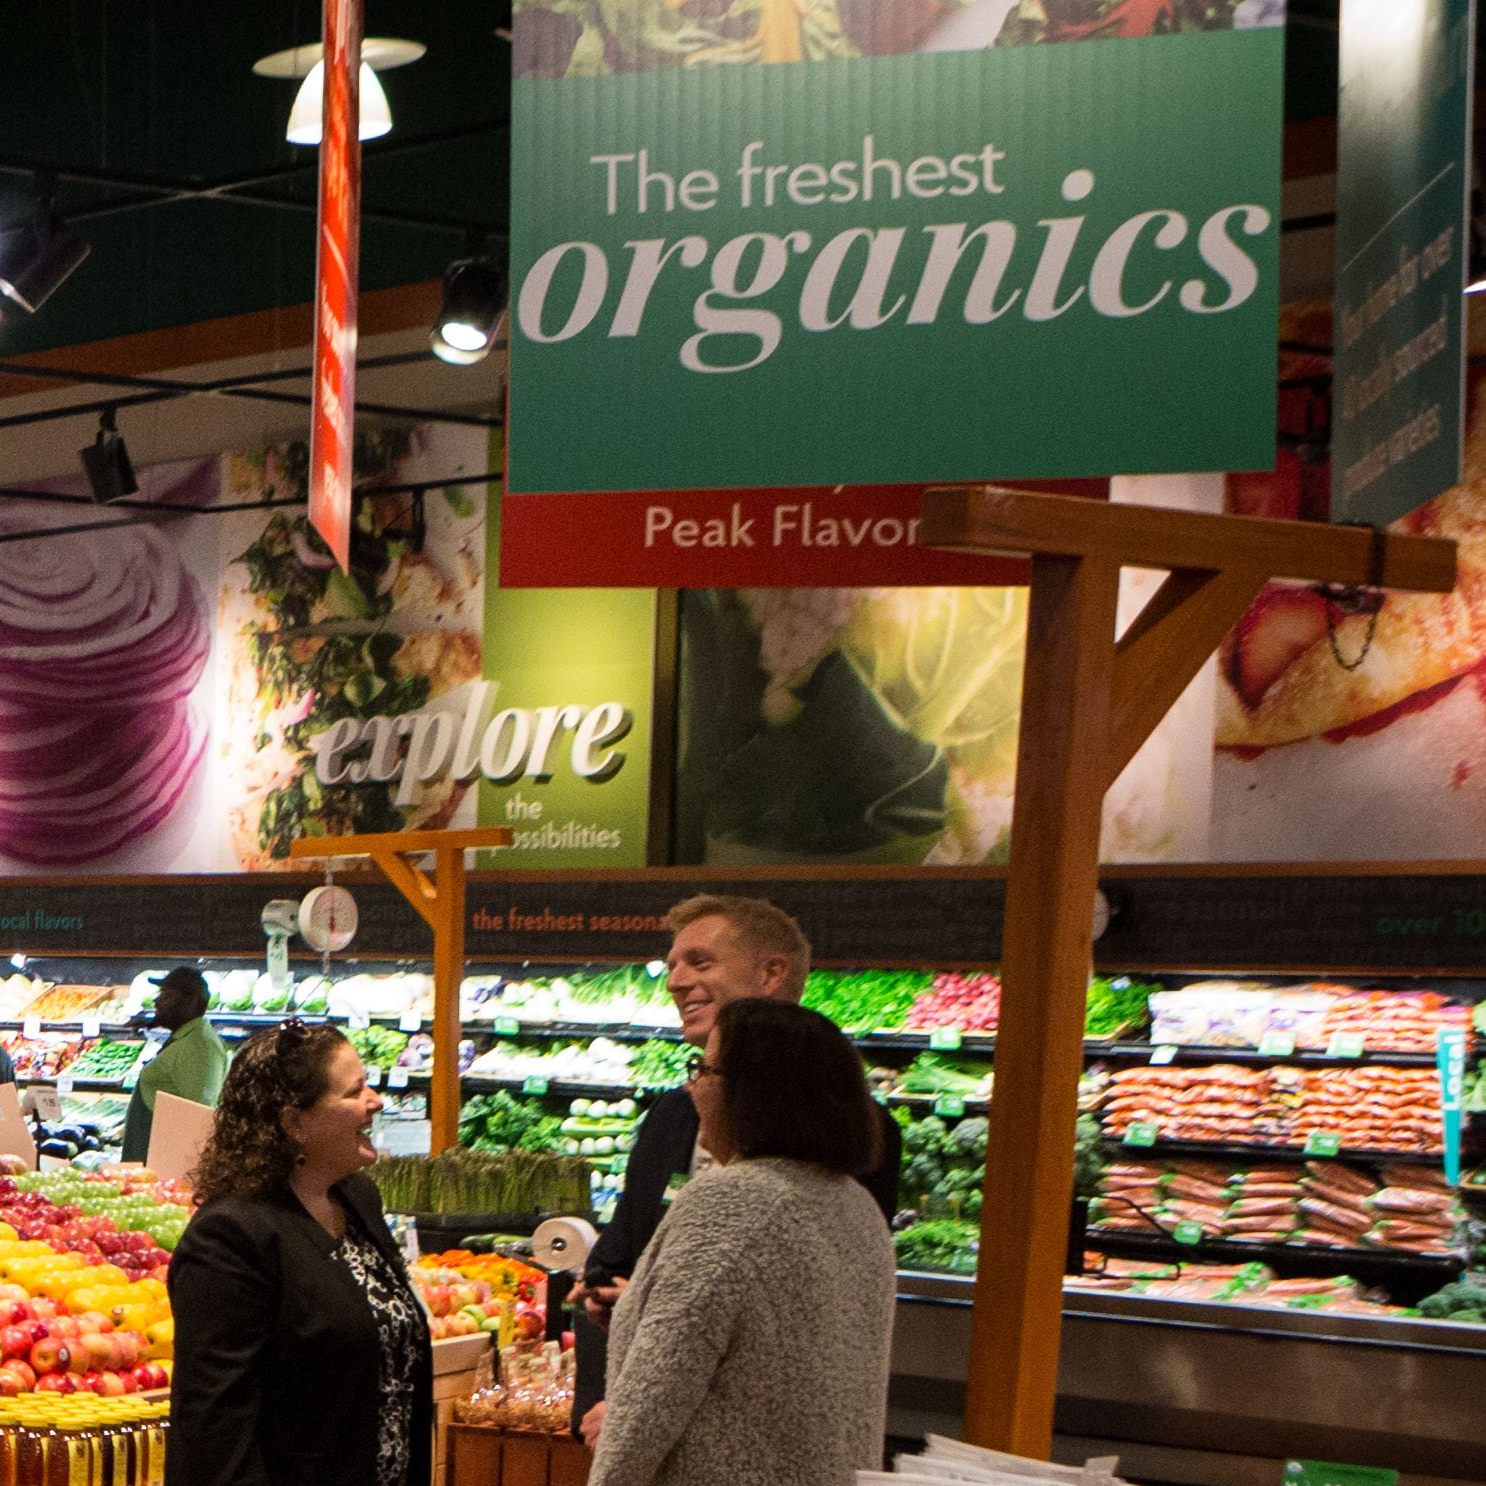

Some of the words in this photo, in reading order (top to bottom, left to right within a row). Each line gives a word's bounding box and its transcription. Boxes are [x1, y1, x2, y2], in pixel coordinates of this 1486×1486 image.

[590, 150, 719, 215] The
[737, 135, 1006, 208] freshest
[517, 169, 1271, 374] organics
[644, 502, 756, 549] Peak
[315, 680, 625, 807] explore
[505, 792, 543, 819] the
[507, 820, 622, 850] ossibilities
[34, 909, 84, 930] flavors
[473, 904, 503, 931] the
[508, 906, 584, 931] freshest
[589, 913, 672, 932] seasona
[1443, 1034, 1464, 1111] Local
